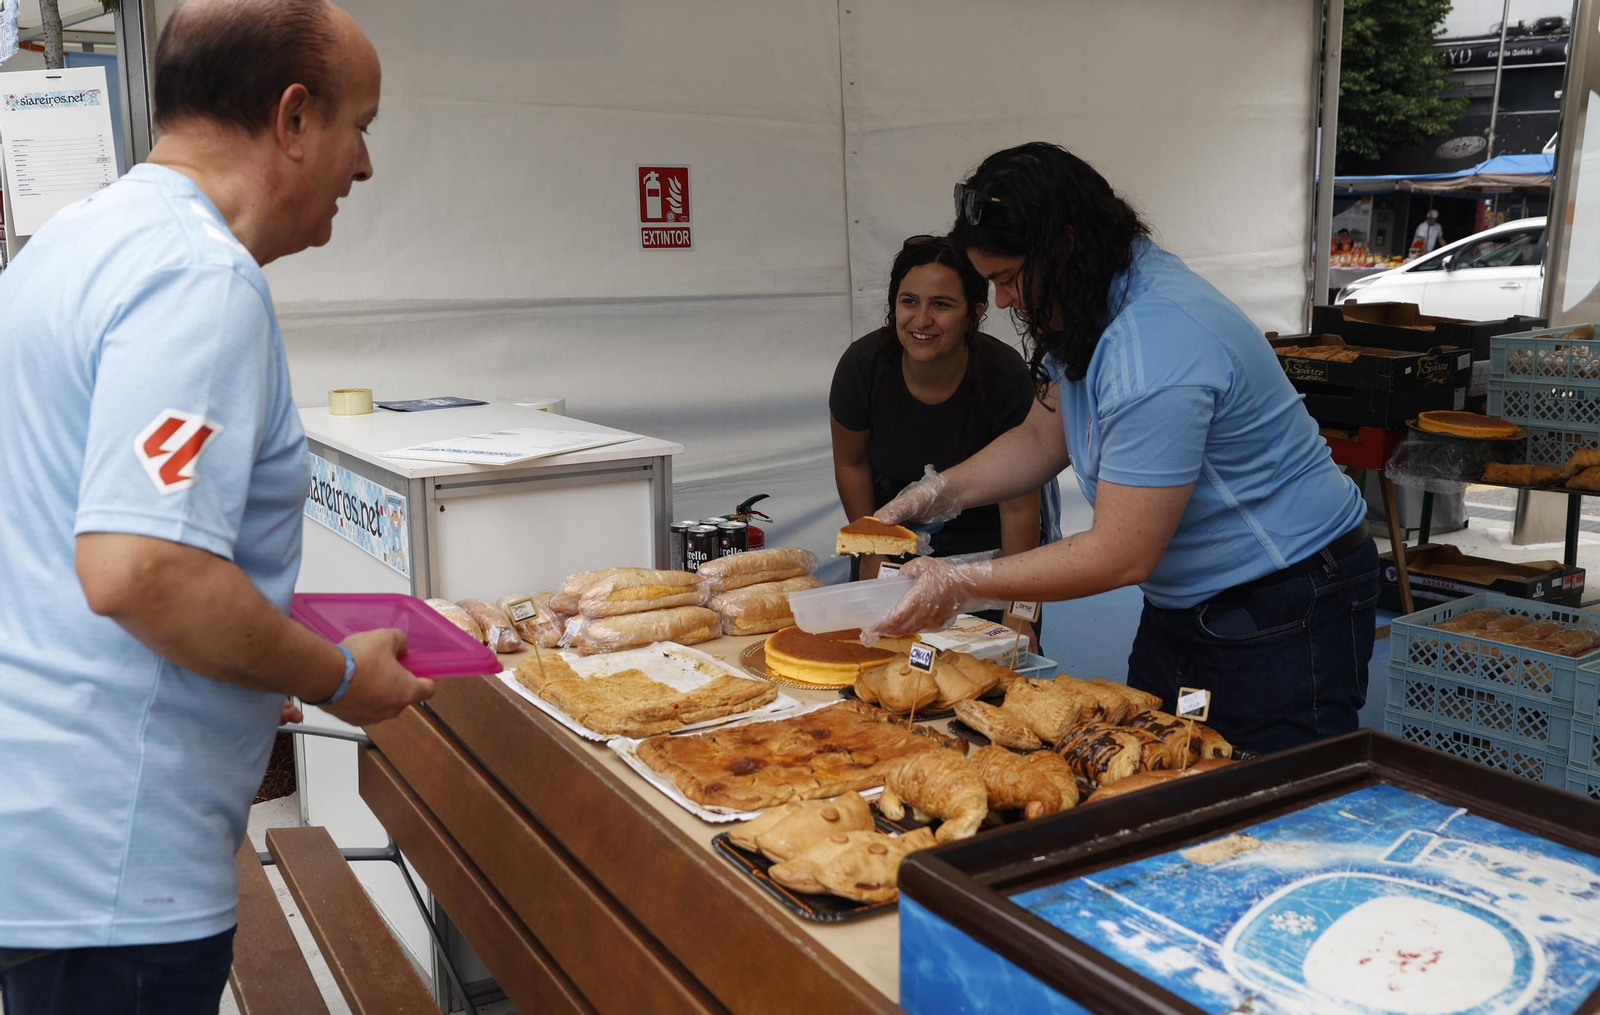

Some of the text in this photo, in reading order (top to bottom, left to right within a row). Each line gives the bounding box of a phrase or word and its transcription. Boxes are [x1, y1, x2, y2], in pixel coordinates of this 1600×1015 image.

[1443, 49, 1472, 65] YD
[20, 93, 86, 107] siareiros.net
[642, 230, 690, 245] EXTINTOR
[307, 473, 382, 538] iareiros.net
